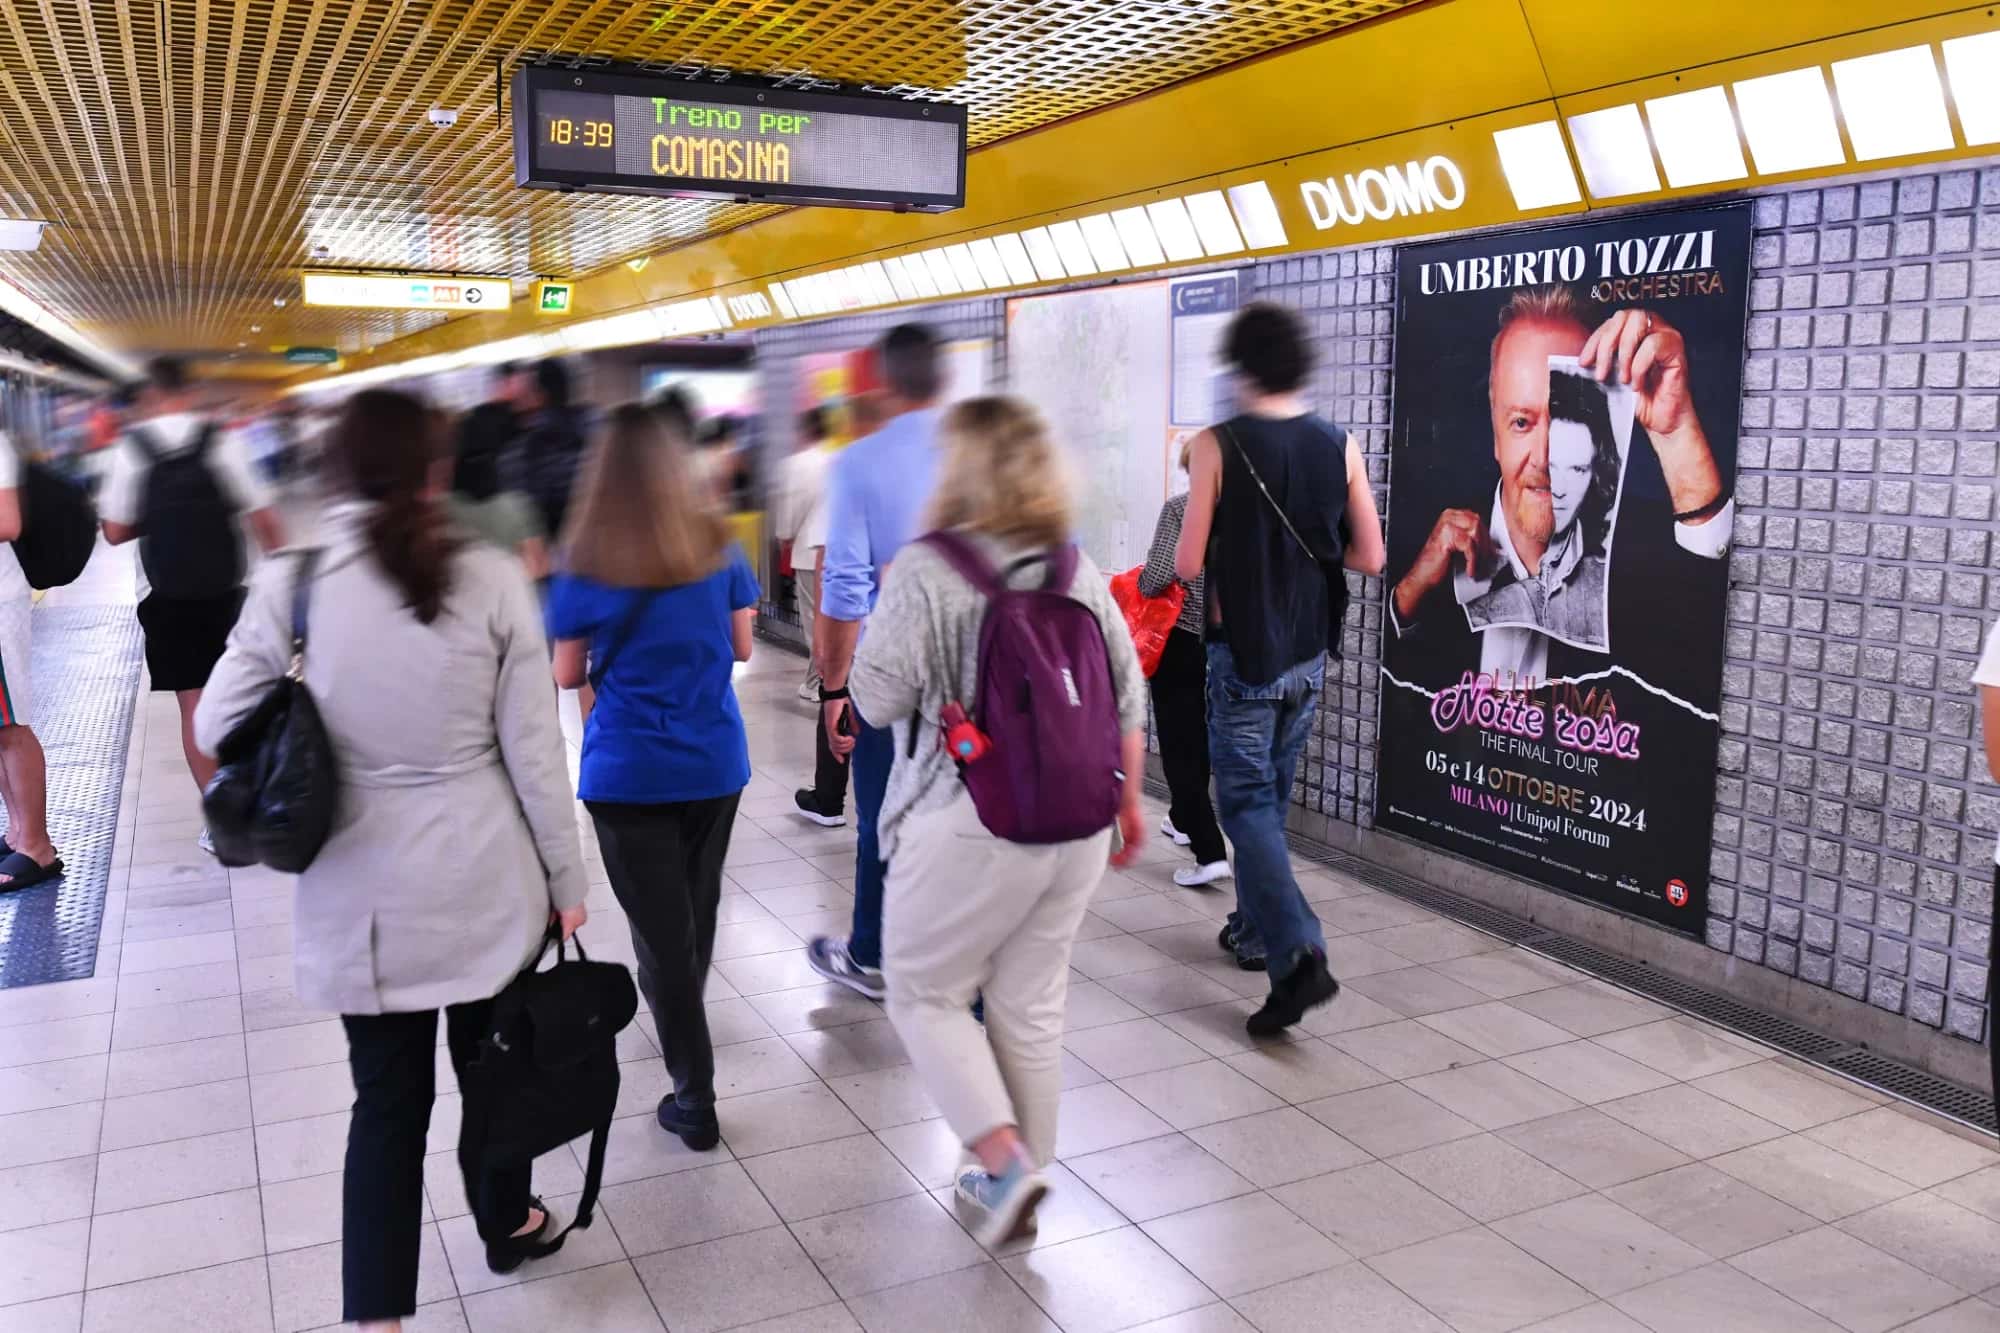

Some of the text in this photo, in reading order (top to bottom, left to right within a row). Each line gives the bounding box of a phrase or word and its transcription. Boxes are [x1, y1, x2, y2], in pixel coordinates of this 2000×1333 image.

[550, 118, 614, 148] 18:39
[651, 97, 811, 134] Treno per
[650, 134, 790, 183] COMASINA
[1299, 155, 1466, 231] DUOMO
[1419, 230, 1717, 296] UMBERTO TOZZI
[1431, 670, 1641, 760] Notte rosa
[1479, 730, 1599, 777] THE FINAL TOUR
[1425, 750, 1647, 832] 05 e 14 OTTOBRE 2024
[1449, 783, 1509, 817] MILANO
[1516, 803, 1560, 833] Unipol
[1564, 818, 1611, 848] Forum
